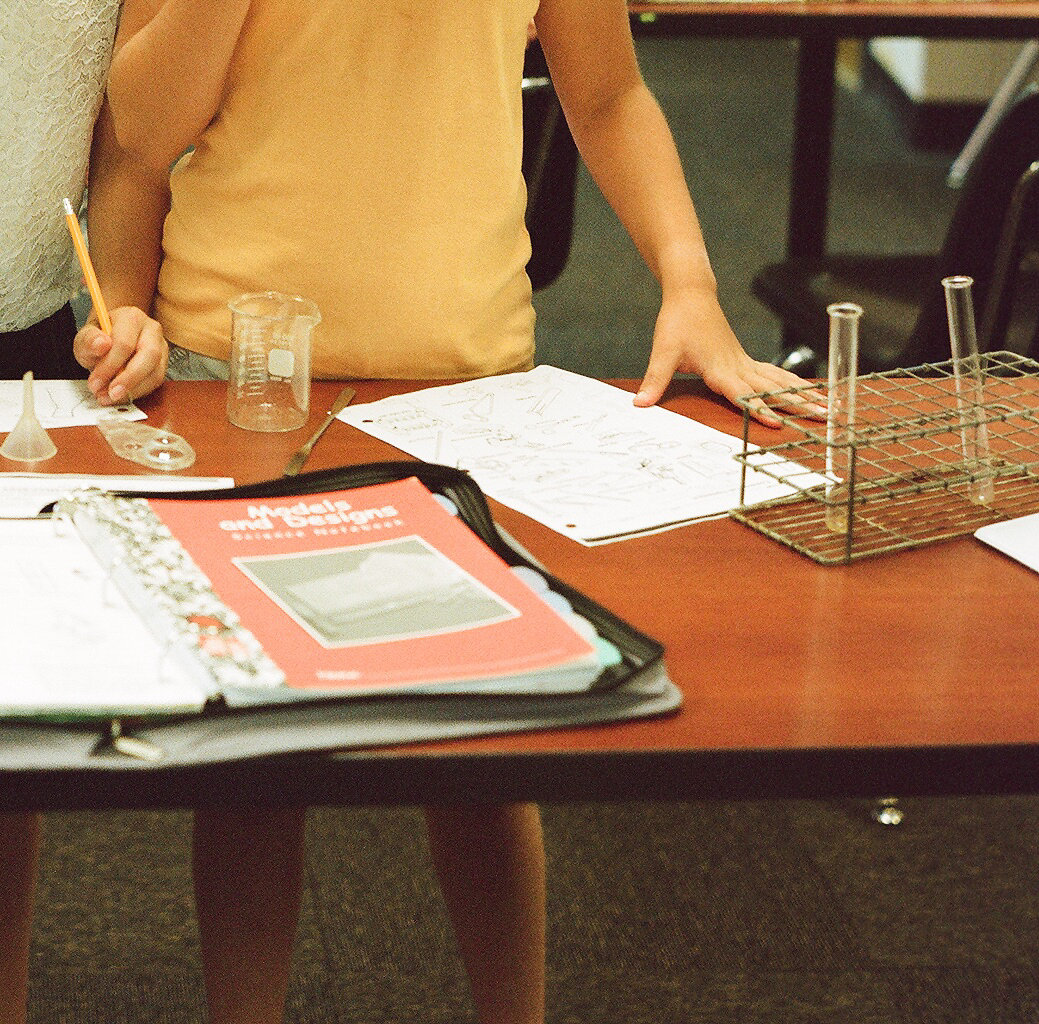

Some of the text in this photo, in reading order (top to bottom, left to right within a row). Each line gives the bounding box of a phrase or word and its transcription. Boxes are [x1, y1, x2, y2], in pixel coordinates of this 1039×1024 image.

[219, 505, 399, 531] and Designs
[247, 499, 352, 519] Models
